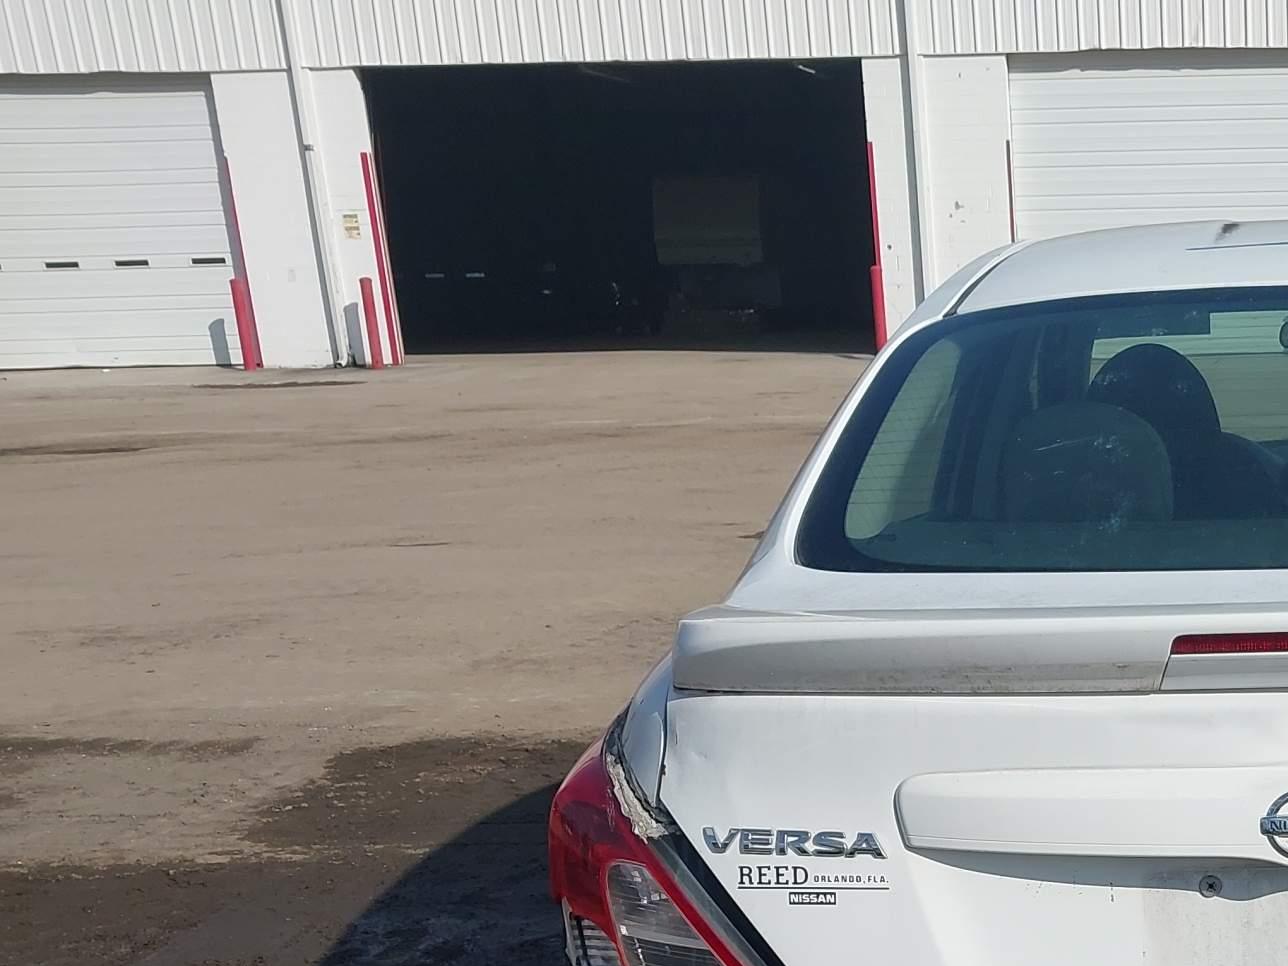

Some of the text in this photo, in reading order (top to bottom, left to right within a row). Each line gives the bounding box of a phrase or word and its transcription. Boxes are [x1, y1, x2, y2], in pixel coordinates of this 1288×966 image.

[702, 827, 887, 859] VERSA
[738, 866, 809, 885] REED
[790, 894, 835, 903] NISSAN
